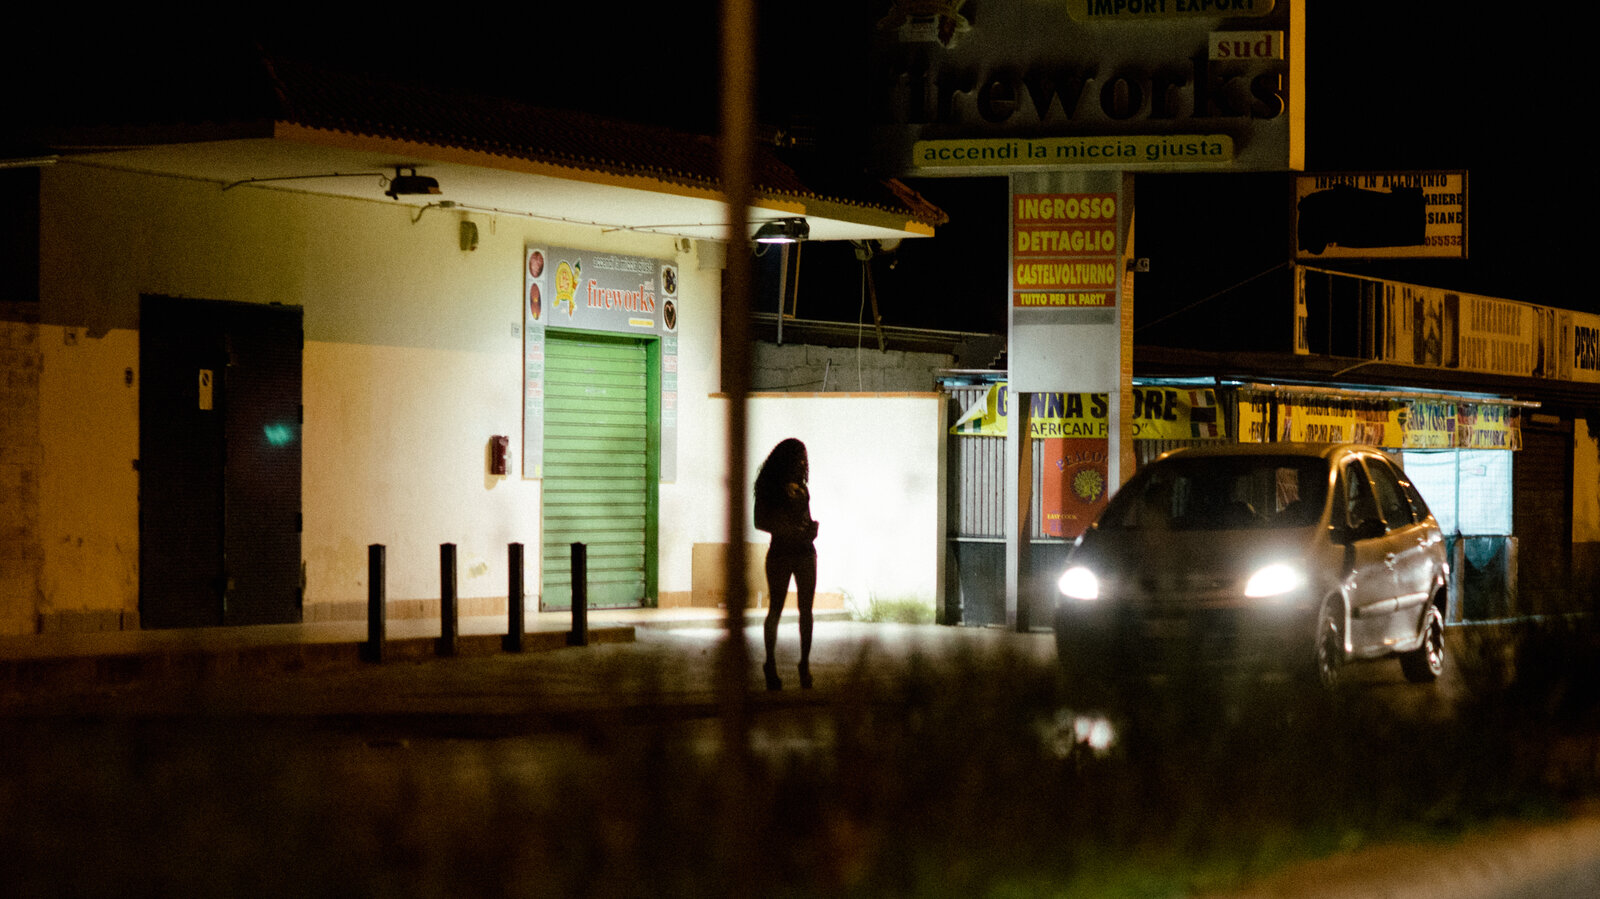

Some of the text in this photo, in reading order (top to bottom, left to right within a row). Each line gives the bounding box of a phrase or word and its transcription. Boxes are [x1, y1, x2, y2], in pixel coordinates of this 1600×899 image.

[1087, 0, 1165, 15] IMPORT
[1218, 35, 1273, 58] sud
[924, 139, 1223, 161] accendi la miccia giusta
[1365, 175, 1376, 187] IN
[1018, 197, 1116, 220] INGROSSO
[1425, 211, 1463, 224] SIANE
[1018, 230, 1116, 252] DETTAGLIO
[1017, 263, 1115, 285] CASTELVOLTURNO
[587, 279, 655, 314] fireworks
[1020, 293, 1106, 306] TUTTO PER IL PARTY
[1574, 325, 1600, 371] PERSI
[997, 386, 1177, 420] GNNA SORE
